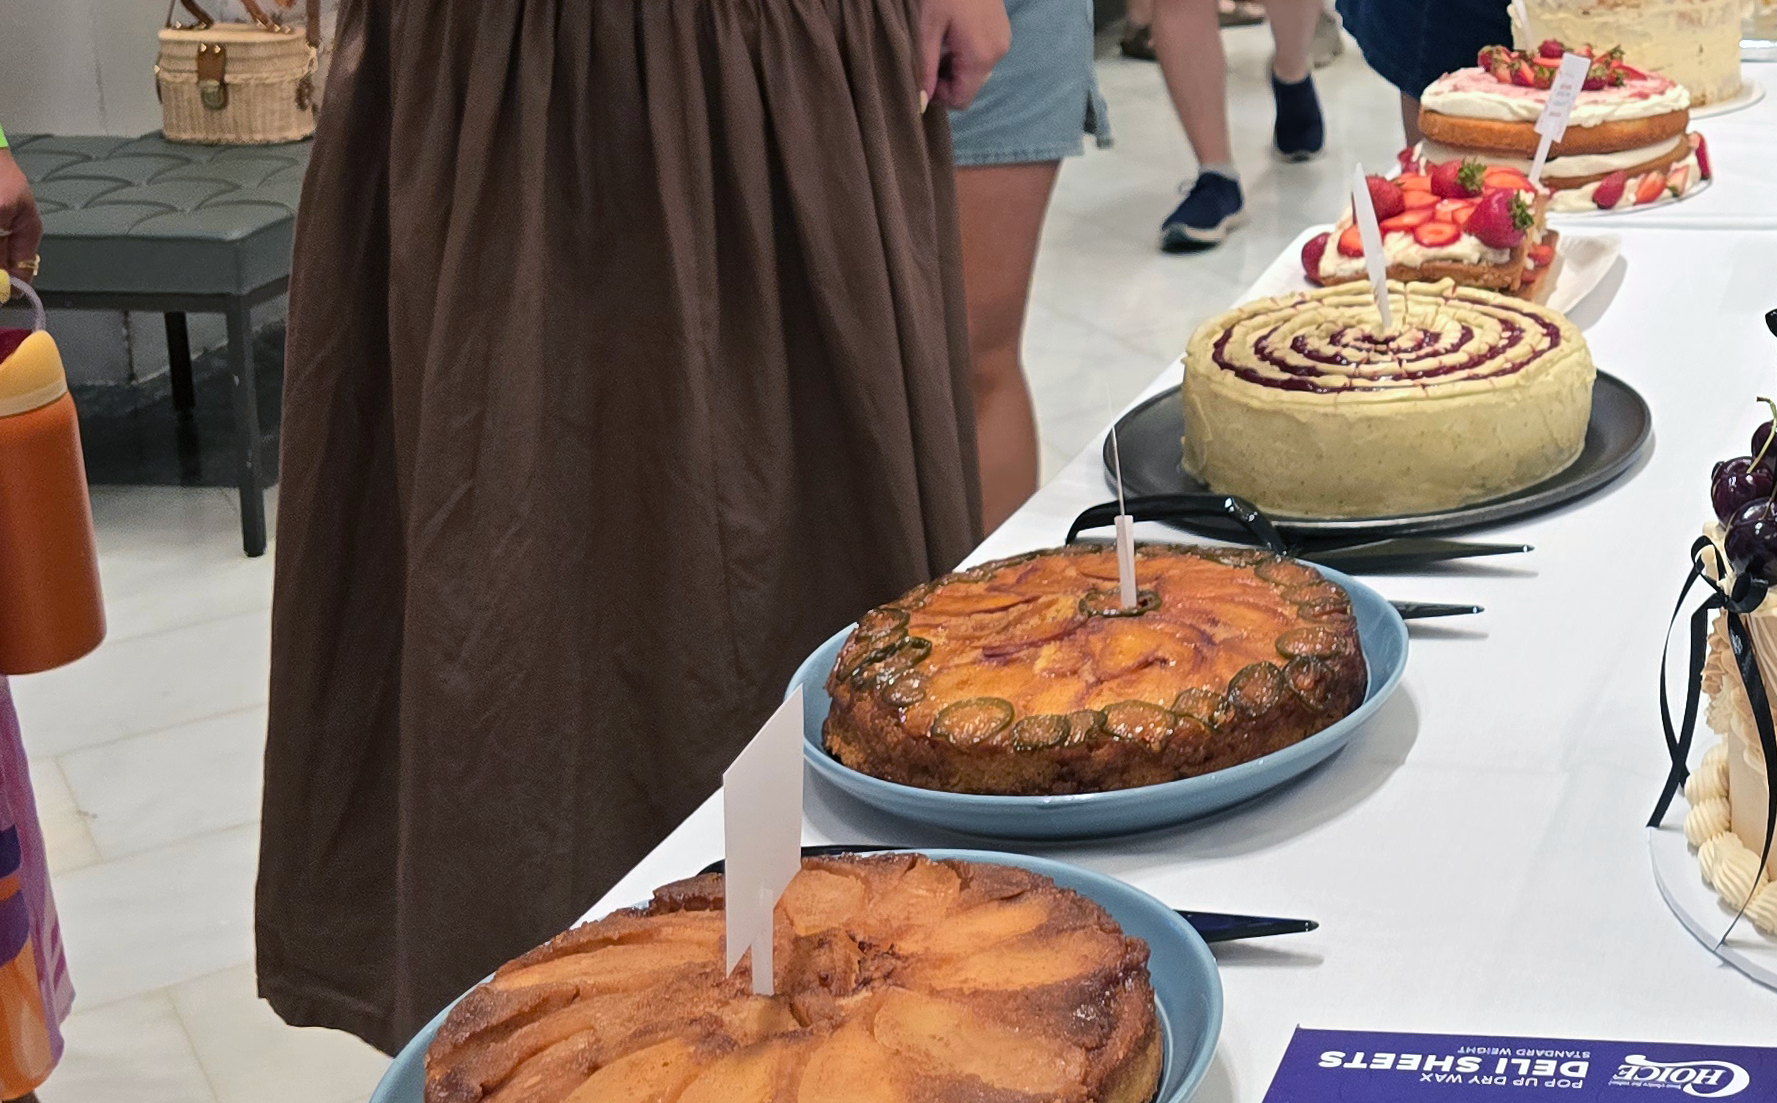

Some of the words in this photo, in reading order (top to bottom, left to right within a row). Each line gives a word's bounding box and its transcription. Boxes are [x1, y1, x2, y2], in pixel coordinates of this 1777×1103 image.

[1457, 1045, 1512, 1056] WEIGHT
[1516, 1049, 1591, 1059] STANDARD
[1318, 1050, 1483, 1073] SHEETS
[1494, 1057, 1590, 1079] DELI
[1419, 1072, 1463, 1084] WAX
[1468, 1075, 1507, 1086] DRY
[1612, 1054, 1750, 1098] CHOICE
[1512, 1077, 1538, 1087] UP
[1544, 1079, 1584, 1090] POP
